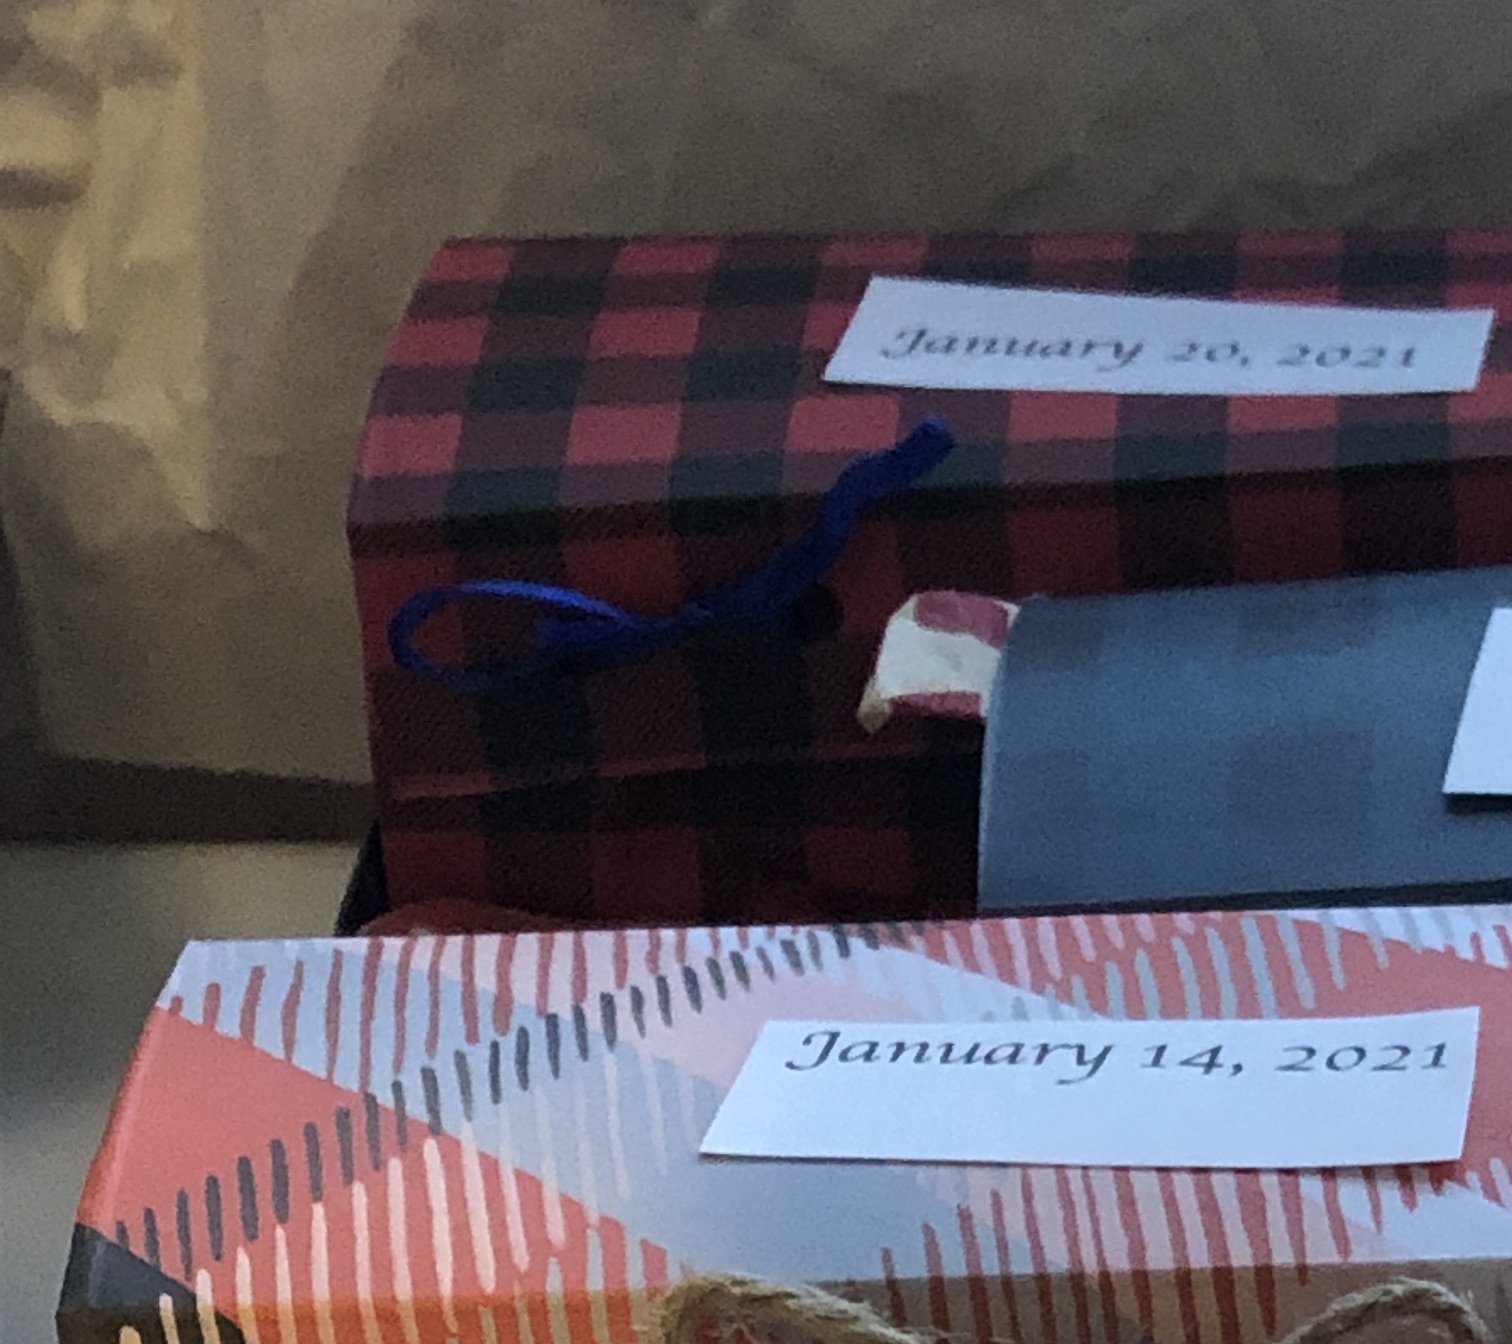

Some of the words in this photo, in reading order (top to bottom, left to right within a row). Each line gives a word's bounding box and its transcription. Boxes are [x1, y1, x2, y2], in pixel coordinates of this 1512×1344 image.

[880, 327, 1145, 372] January
[1170, 340, 1250, 367] 20,
[1276, 343, 1416, 368] 2021
[785, 1030, 1114, 1086] January
[1149, 1043, 1244, 1077] 14,
[1275, 1042, 1447, 1072] 2021
